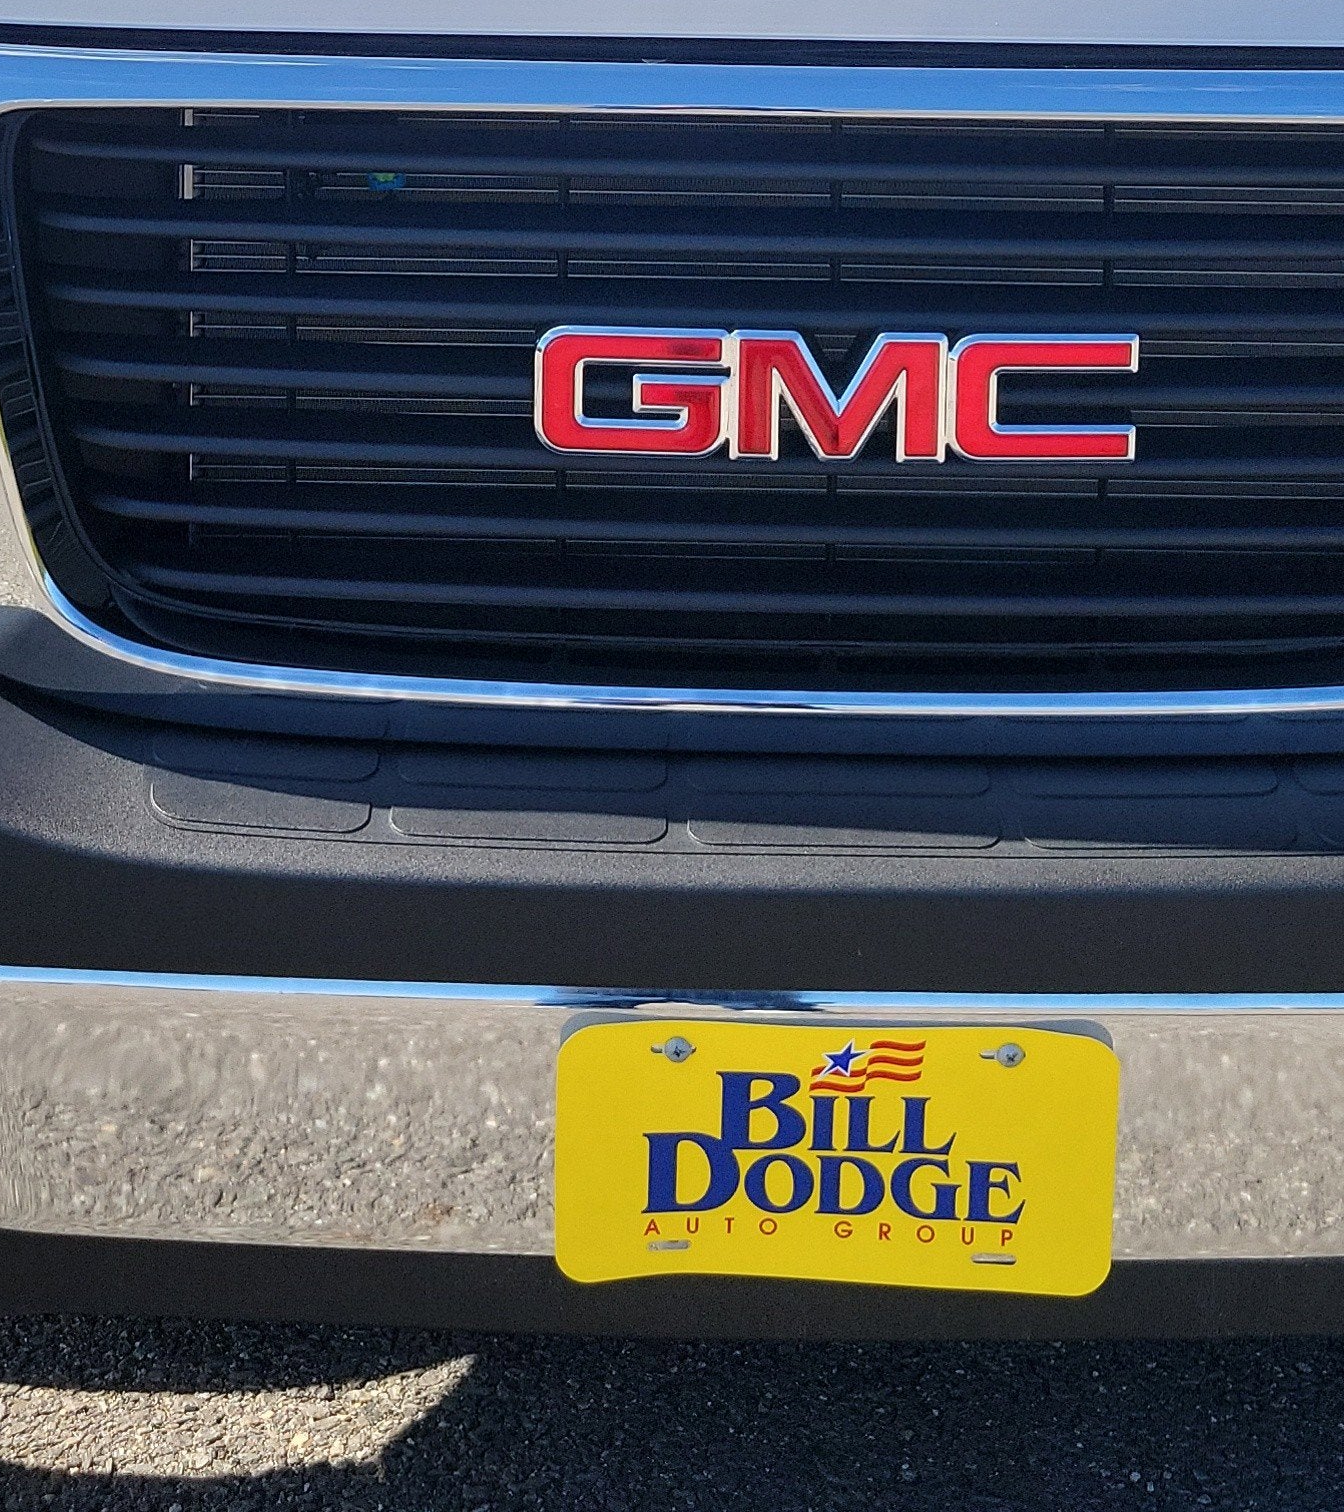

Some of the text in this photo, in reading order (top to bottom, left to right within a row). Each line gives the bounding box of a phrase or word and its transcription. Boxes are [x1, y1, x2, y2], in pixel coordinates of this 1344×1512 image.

[534, 325, 1139, 462] GMC
[716, 1070, 957, 1155] BILL
[641, 1132, 1026, 1224] DODGE
[643, 1217, 1014, 1247] AUTO GROUP
